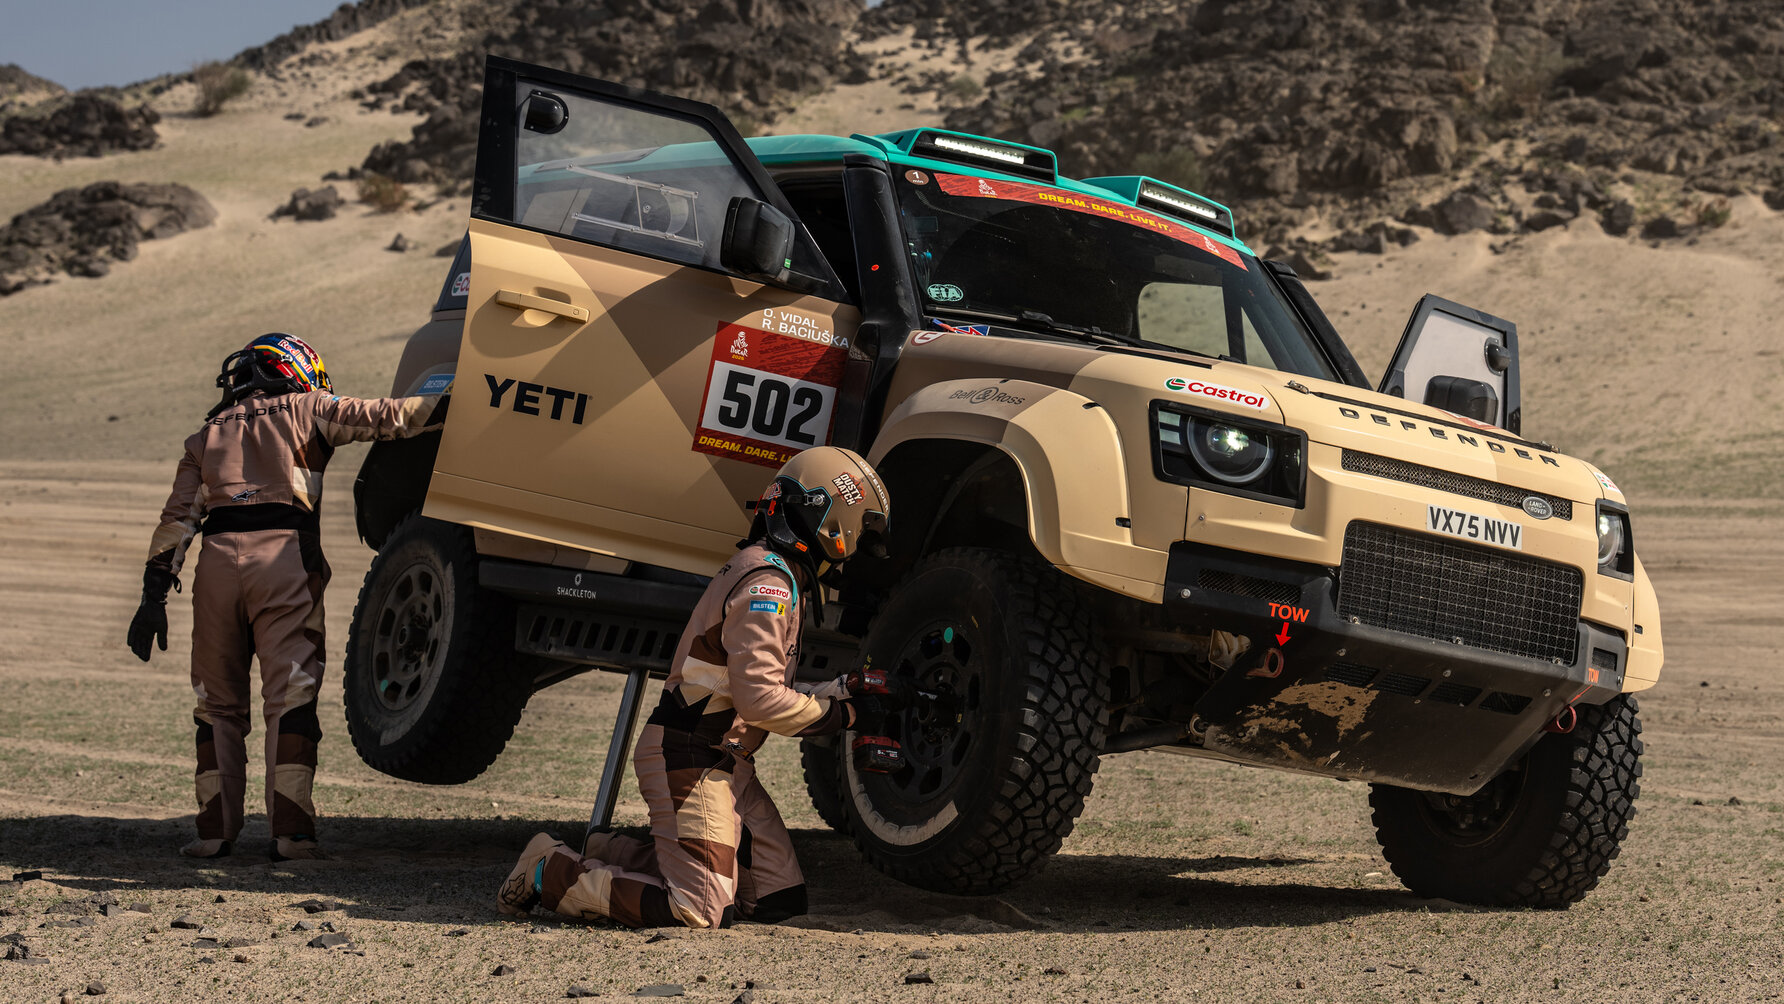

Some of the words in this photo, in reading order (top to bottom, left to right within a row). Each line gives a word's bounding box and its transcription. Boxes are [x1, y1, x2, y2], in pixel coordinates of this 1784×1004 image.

[1038, 192, 1090, 209] DREAM.
[1091, 203, 1129, 218] DARE.
[1130, 213, 1157, 227] LIVE
[1158, 222, 1172, 233] IT.
[929, 286, 961, 299] FIA
[763, 308, 776, 319] O.
[780, 311, 819, 329] VIDAL
[762, 318, 774, 330] R.
[779, 322, 849, 348] BACIUŠKA
[278, 339, 300, 356] Red
[296, 353, 313, 374] Bull
[484, 373, 588, 425] YETI
[718, 370, 823, 446] 502
[949, 390, 976, 400] Bell
[992, 392, 1026, 405] Ross
[1188, 382, 1264, 408] Castrol
[698, 435, 742, 453] DREAM.
[744, 445, 778, 461] DARE.
[780, 453, 793, 463] LI
[1339, 406, 1560, 468] DEFENDER
[833, 478, 856, 506] MATCH
[840, 473, 863, 500] DUSTY
[859, 461, 889, 512] DEFENDER
[1429, 506, 1480, 538] VX75
[1484, 518, 1520, 547] NVV
[557, 586, 597, 599] SHACKLETON
[759, 586, 789, 598] Castrol
[1268, 602, 1310, 623] TOW
[1588, 667, 1600, 684] TOW
